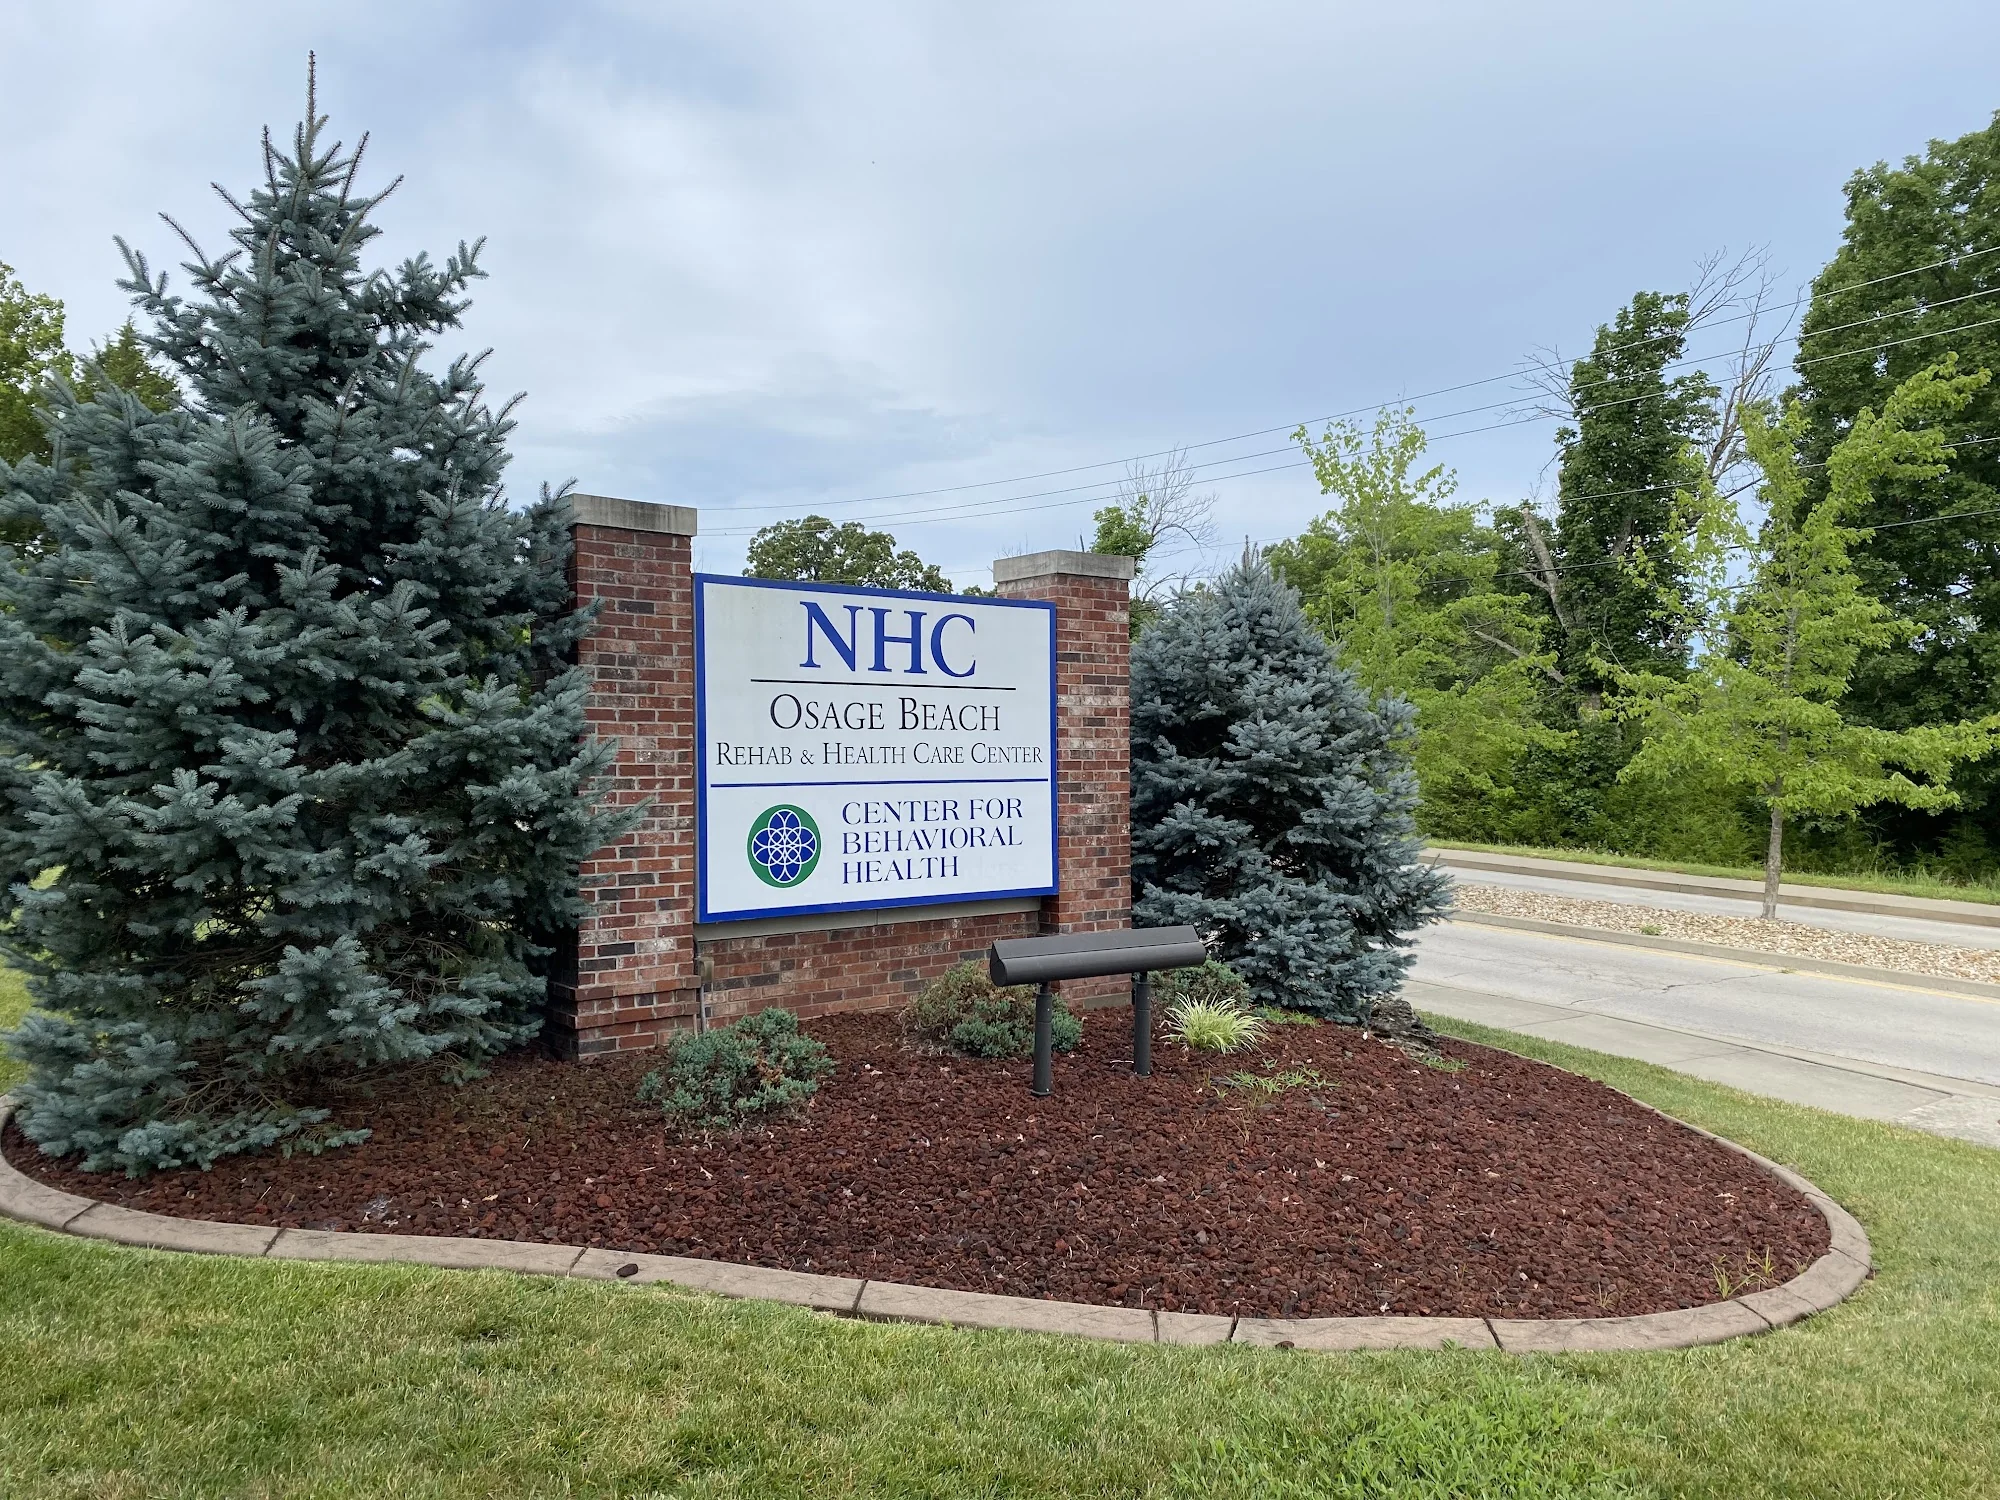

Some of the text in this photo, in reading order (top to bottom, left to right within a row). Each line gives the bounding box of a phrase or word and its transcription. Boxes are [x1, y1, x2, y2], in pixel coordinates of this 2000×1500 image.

[799, 601, 976, 678] NHC
[770, 693, 1001, 731] OSAGE BEACH
[716, 742, 1043, 766] REHAB & HEALTH CARE CENTER
[842, 797, 1023, 826] CENTER FOR
[842, 825, 1023, 855] BEHAVIORAL
[842, 856, 959, 884] HEALTH
